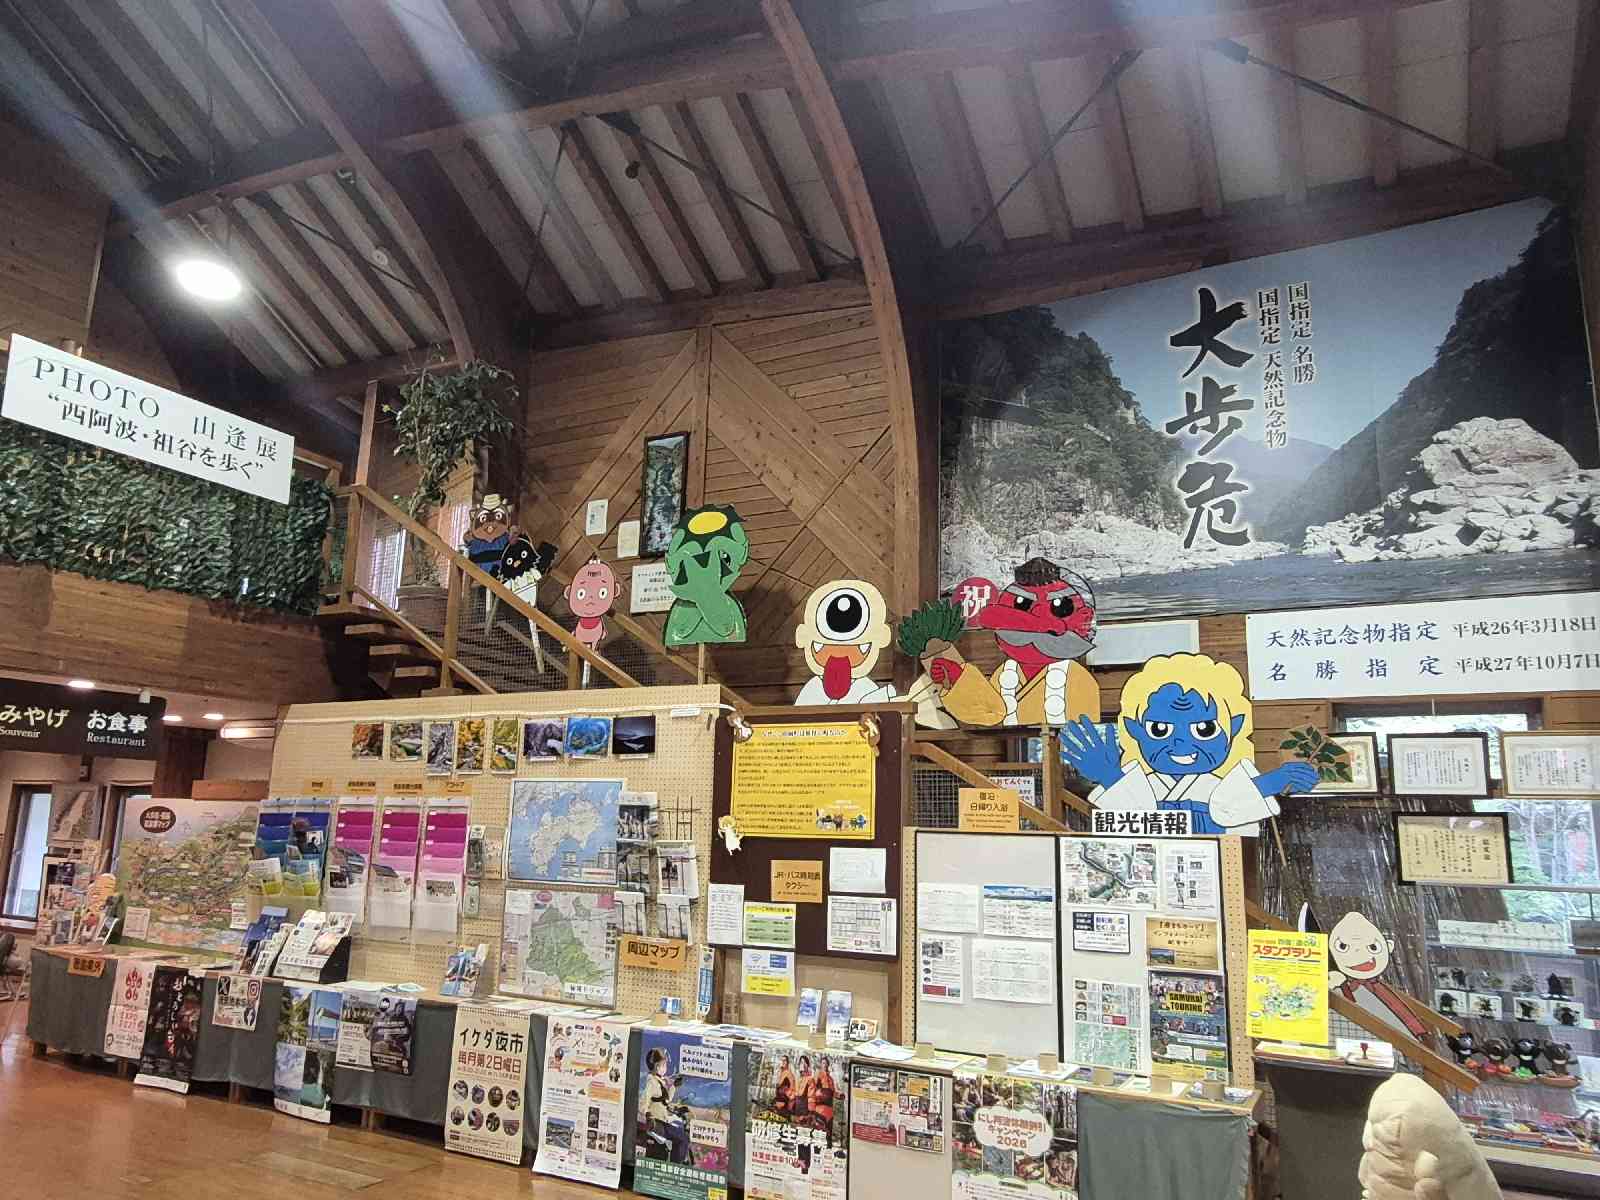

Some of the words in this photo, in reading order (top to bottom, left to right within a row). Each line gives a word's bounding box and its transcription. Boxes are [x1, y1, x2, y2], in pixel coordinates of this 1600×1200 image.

[1257, 288, 1282, 346] 国指定
[1288, 281, 1312, 341] 国指定
[1293, 345, 1315, 384] 名勝
[32, 357, 160, 419] PHOTO
[1263, 350, 1287, 449] 天然記念物
[1165, 287, 1254, 549] 大歩危
[960, 585, 991, 617] 祝
[1266, 620, 1440, 649] 天然記念物指定
[1451, 616, 1596, 639] 平成26年3月18日
[1455, 653, 1600, 674] 平成27年10月7日
[0, 704, 70, 728] みやげ
[87, 710, 148, 733] お食事
[0, 726, 41, 739] Souvenir
[87, 732, 146, 747] Restaurant
[970, 803, 1008, 813] 日帰り入浴
[1094, 811, 1187, 834] 観光情報
[785, 882, 809, 890] タクシー
[628, 941, 680, 960] 周辺マップ
[1252, 943, 1321, 959] スタンプラリー
[1169, 992, 1203, 1003] SAMURAI
[1170, 1001, 1203, 1012] TOURING
[460, 1028, 524, 1054] イケダ夜市
[458, 1051, 522, 1074] 毎月第2日曜日
[988, 1125, 1036, 1139] キャンペーン
